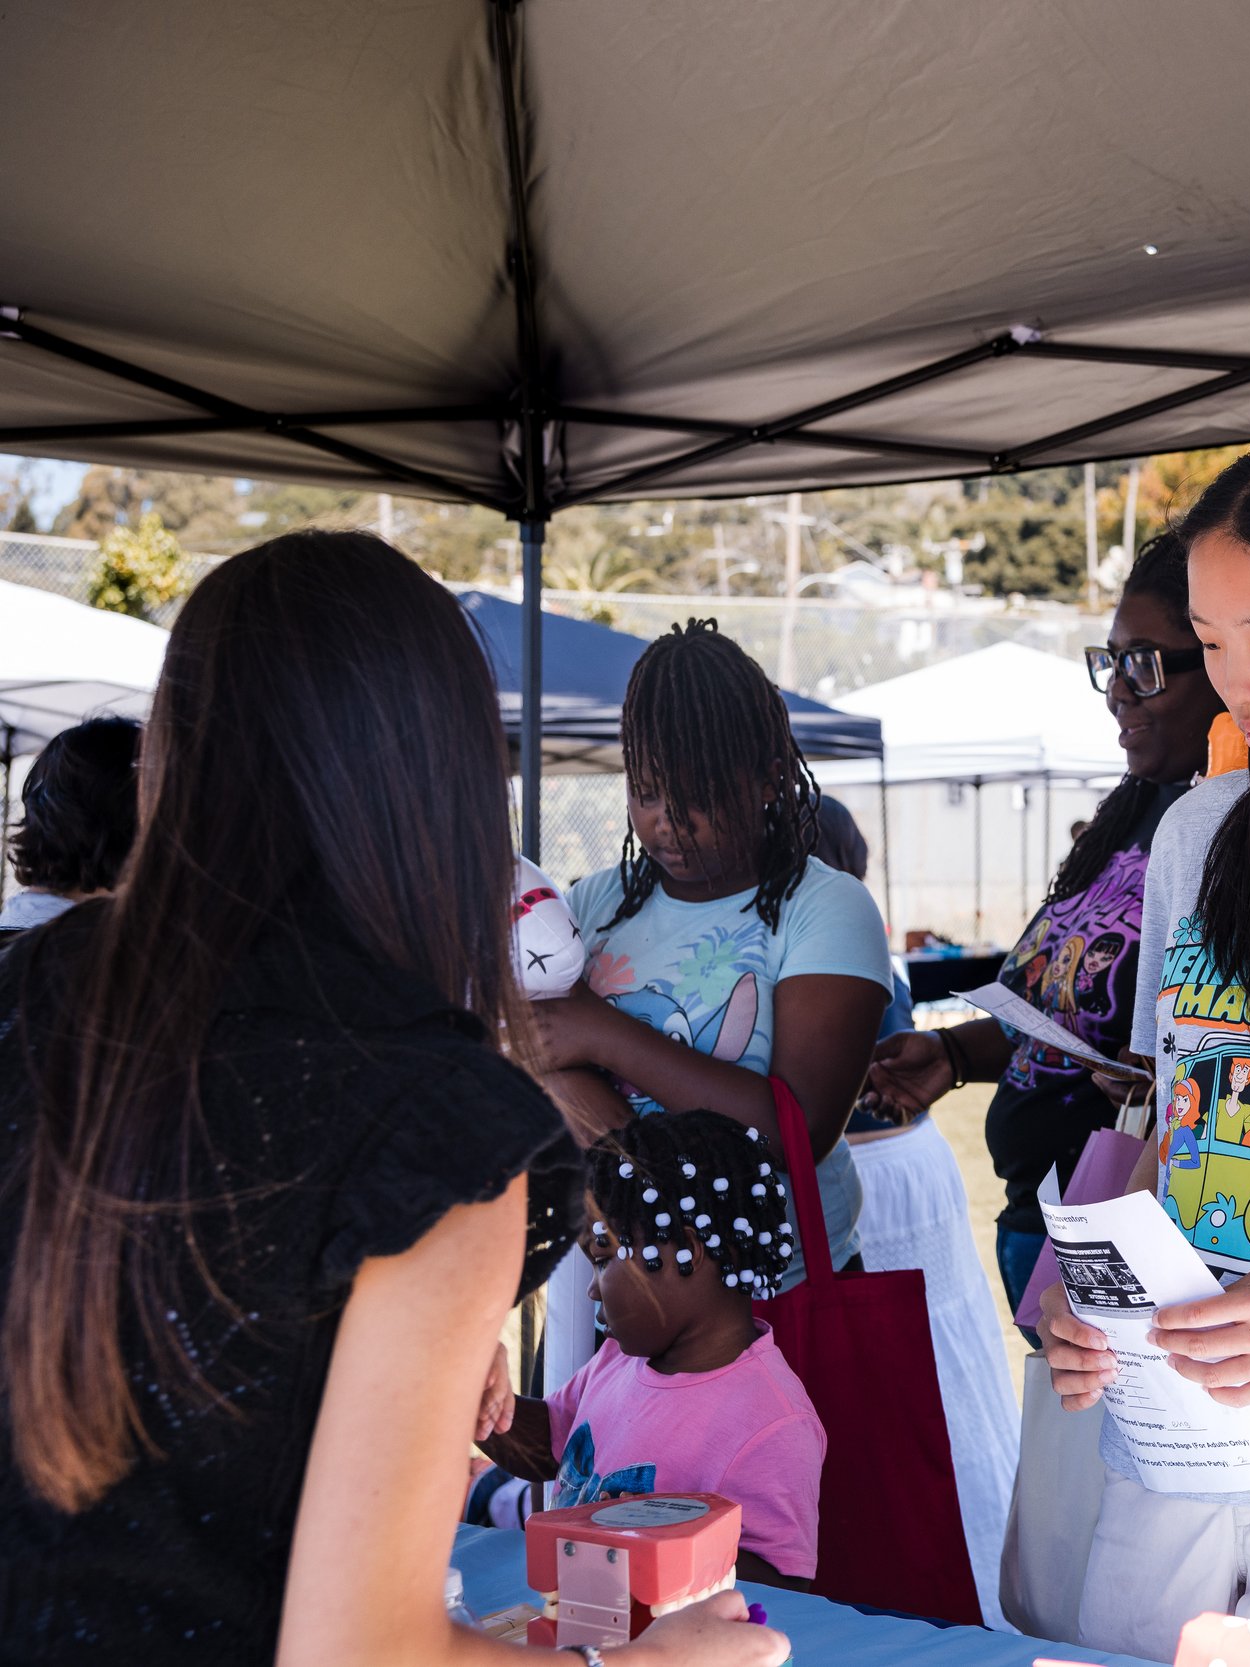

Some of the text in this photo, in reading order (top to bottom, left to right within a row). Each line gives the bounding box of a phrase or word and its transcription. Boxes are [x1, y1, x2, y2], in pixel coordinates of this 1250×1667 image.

[1160, 945, 1201, 988] HE
[1052, 1214, 1088, 1224] Inventory
[1116, 1360, 1144, 1368] ategories:
[1137, 1421, 1166, 1431] language:
[1135, 1438, 1157, 1448] General
[1156, 1441, 1176, 1450] Swag
[1174, 1442, 1192, 1450] Bags
[1191, 1442, 1206, 1450] (For
[1146, 1459, 1162, 1467] Food
[1184, 1460, 1207, 1469] (Entire
